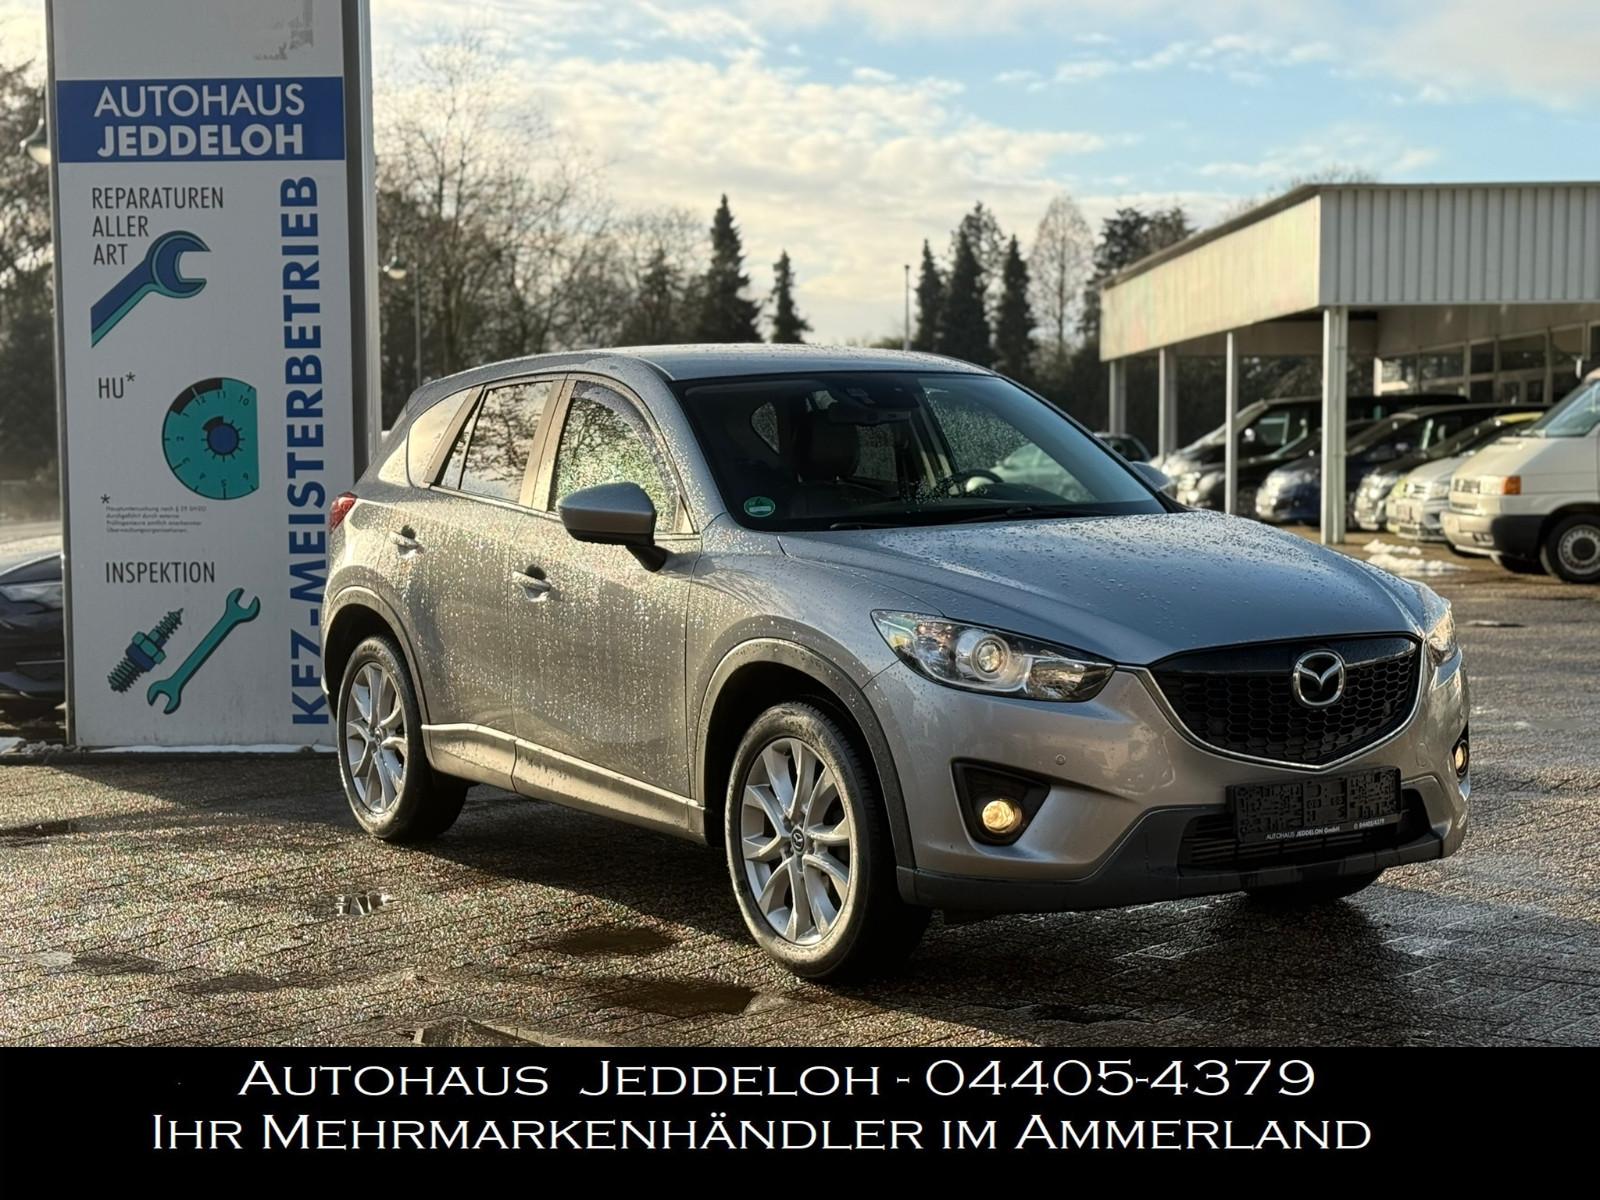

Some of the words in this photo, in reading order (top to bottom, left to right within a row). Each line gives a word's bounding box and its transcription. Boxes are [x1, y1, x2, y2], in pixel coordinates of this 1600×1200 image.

[94, 83, 305, 118] AUTOHAUS
[97, 123, 304, 157] JEDDELOH
[92, 186, 224, 209] REPARATUREN
[92, 215, 149, 237] ALLER
[93, 243, 128, 265] ART
[280, 176, 329, 725] KFZ-MEISTERBETRIEB
[105, 561, 215, 584] INSPEKTION
